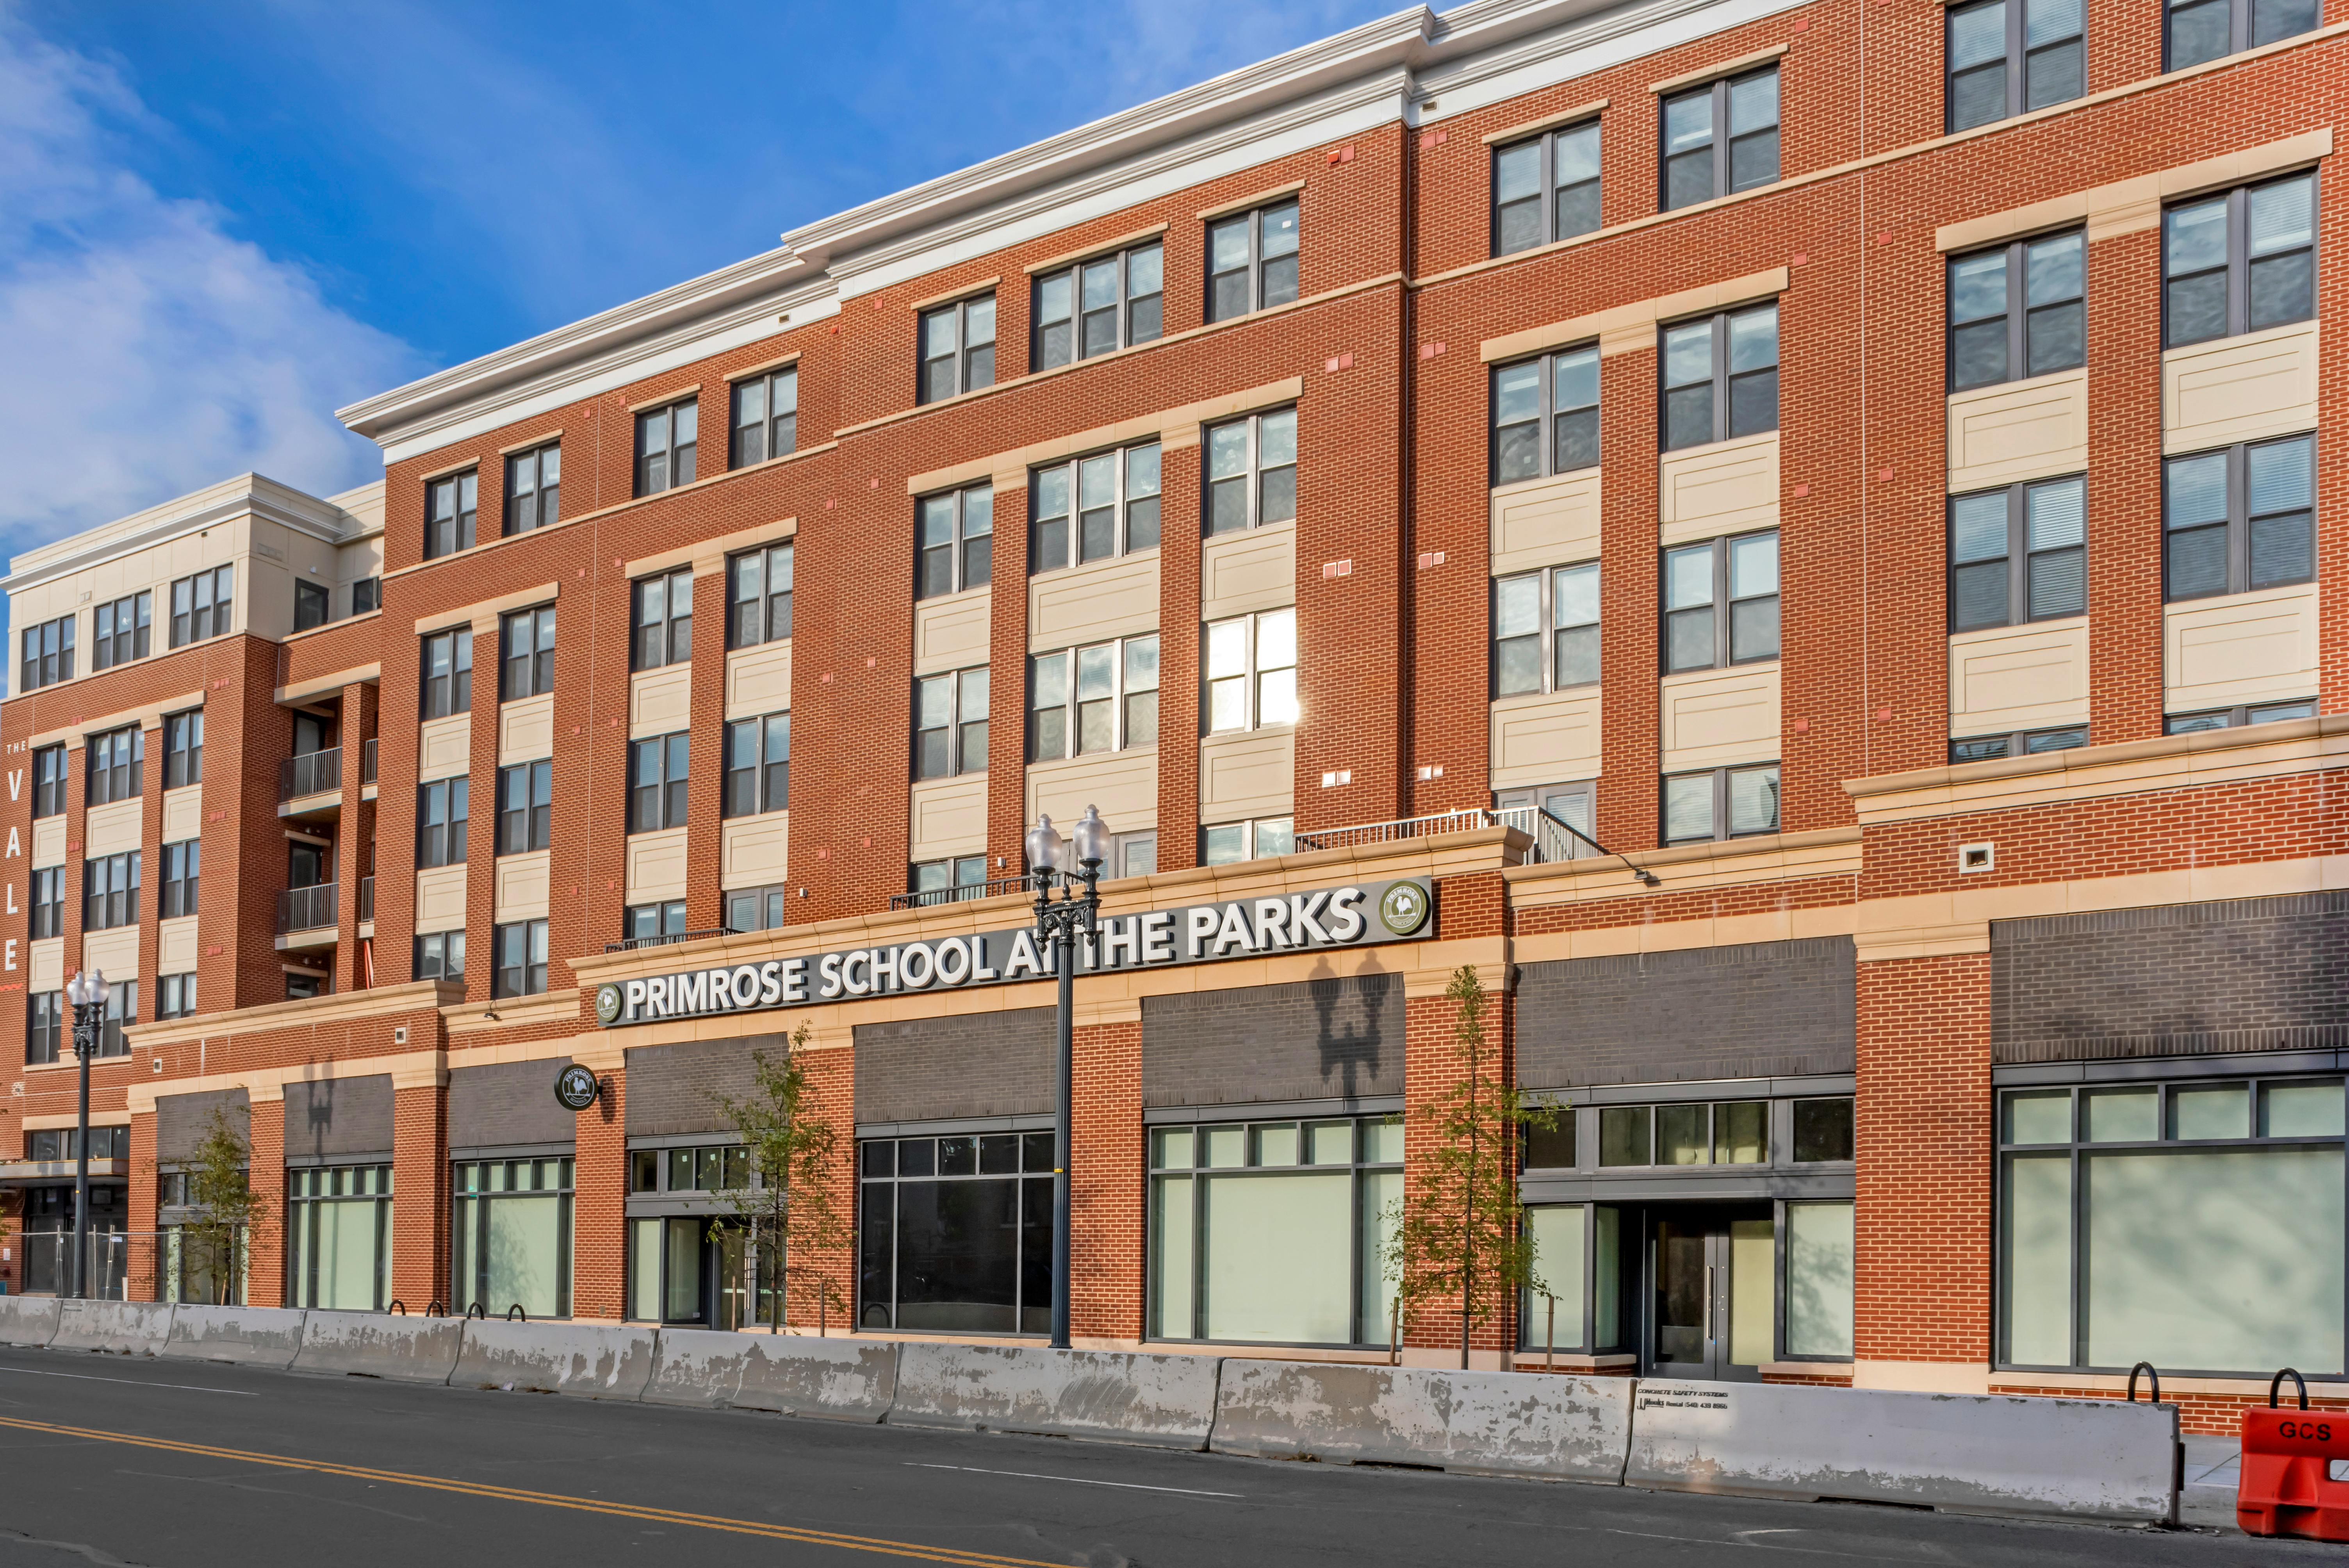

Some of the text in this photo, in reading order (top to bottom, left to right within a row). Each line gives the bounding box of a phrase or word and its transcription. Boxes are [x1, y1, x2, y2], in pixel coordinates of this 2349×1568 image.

[7, 741, 25, 754] THE
[5, 769, 23, 971] VALE
[1387, 888, 1418, 903] PRIMROSE
[627, 959, 804, 1018] PRIMROSE
[820, 936, 995, 997] SCHOOL
[1074, 912, 1171, 968] THE
[1188, 887, 1362, 956] PARKS
[565, 1070, 592, 1085] PRIMROSE
[2279, 1422, 2331, 1441] GCS
